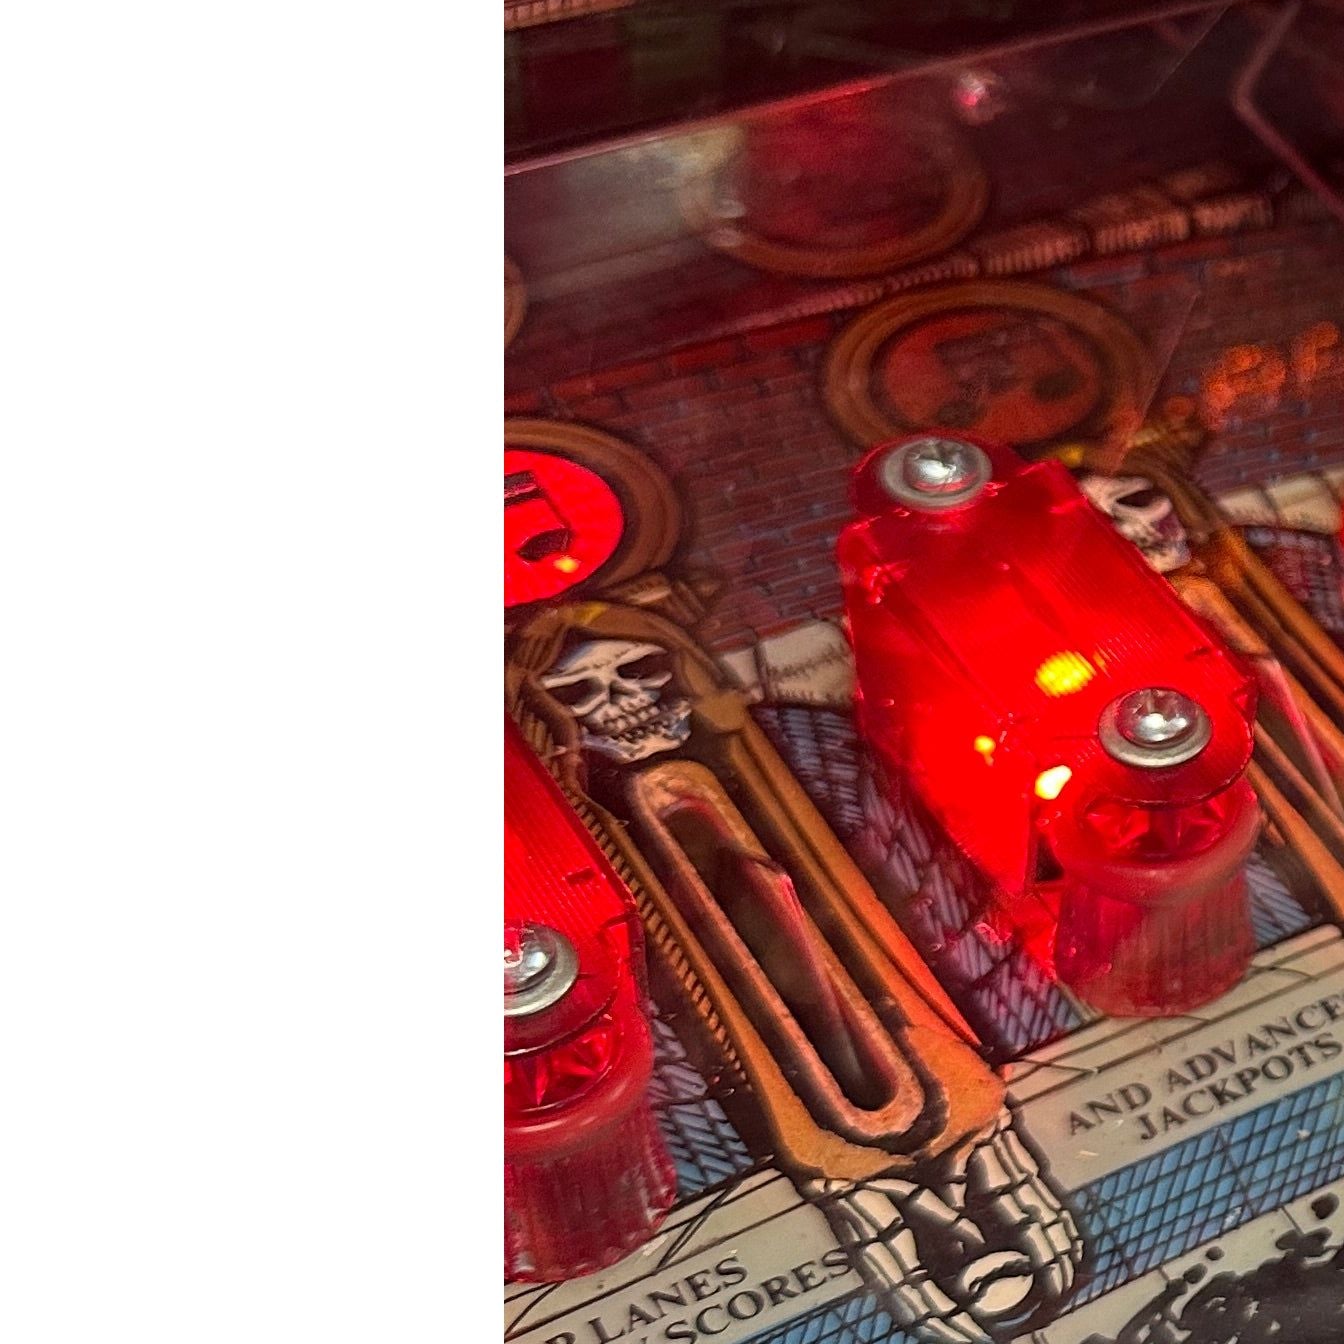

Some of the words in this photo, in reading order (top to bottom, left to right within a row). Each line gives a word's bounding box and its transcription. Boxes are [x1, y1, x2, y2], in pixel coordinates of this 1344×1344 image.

[1067, 1083, 1152, 1136] AND
[1138, 1032, 1343, 1141] JACKPOTS
[588, 1256, 748, 1344] LANES
